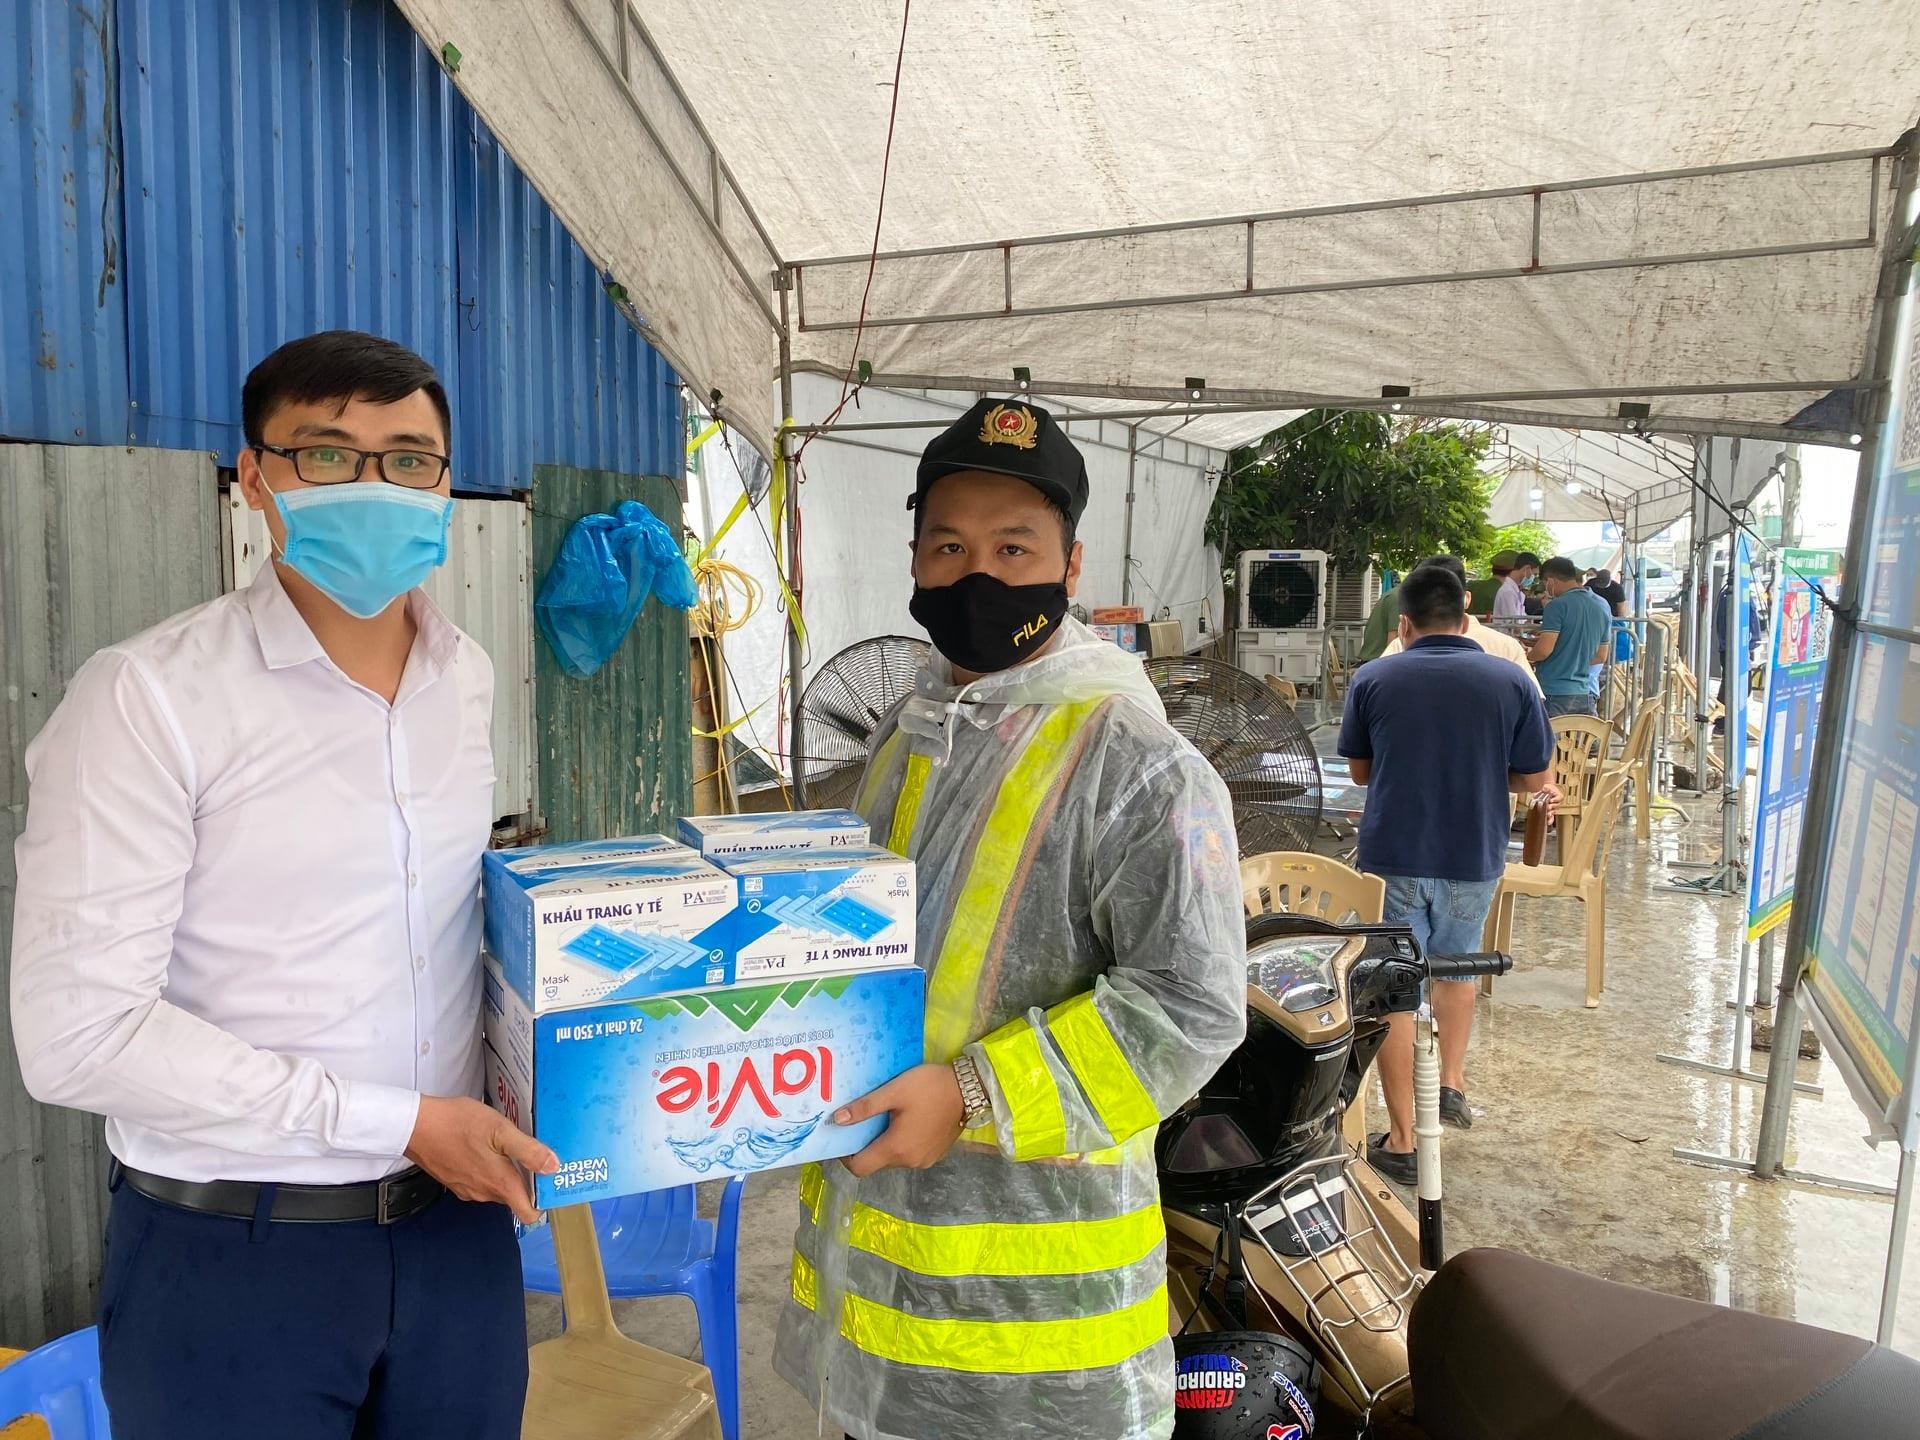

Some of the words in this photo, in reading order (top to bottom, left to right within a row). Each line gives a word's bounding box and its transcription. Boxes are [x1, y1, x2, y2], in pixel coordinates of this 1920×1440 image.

[1011, 613, 1049, 648] FILA
[830, 835, 848, 846] PA
[683, 892, 704, 905] PA
[887, 889, 910, 899] Mask
[542, 905, 583, 924] KHẨU
[588, 903, 632, 919] TRANG
[633, 902, 644, 914] Y
[647, 896, 664, 913] TẾ
[803, 951, 818, 965] TẾ
[821, 949, 830, 960] Y
[832, 946, 872, 959] TRANG
[875, 943, 909, 959] KHẨU
[765, 957, 786, 968] PA
[542, 974, 570, 986] Mask
[573, 1024, 595, 1040] 350
[595, 1023, 605, 1035] x
[605, 1020, 629, 1037] chai
[630, 1018, 644, 1034] 24
[556, 1027, 571, 1042] ml
[808, 1028, 834, 1044] 100%
[726, 1035, 775, 1056] KHOÁNG
[553, 1168, 608, 1191] Nestlé
[1176, 1371, 1246, 1390] GRIDIRO
[1175, 1390, 1235, 1410] TEXANS
